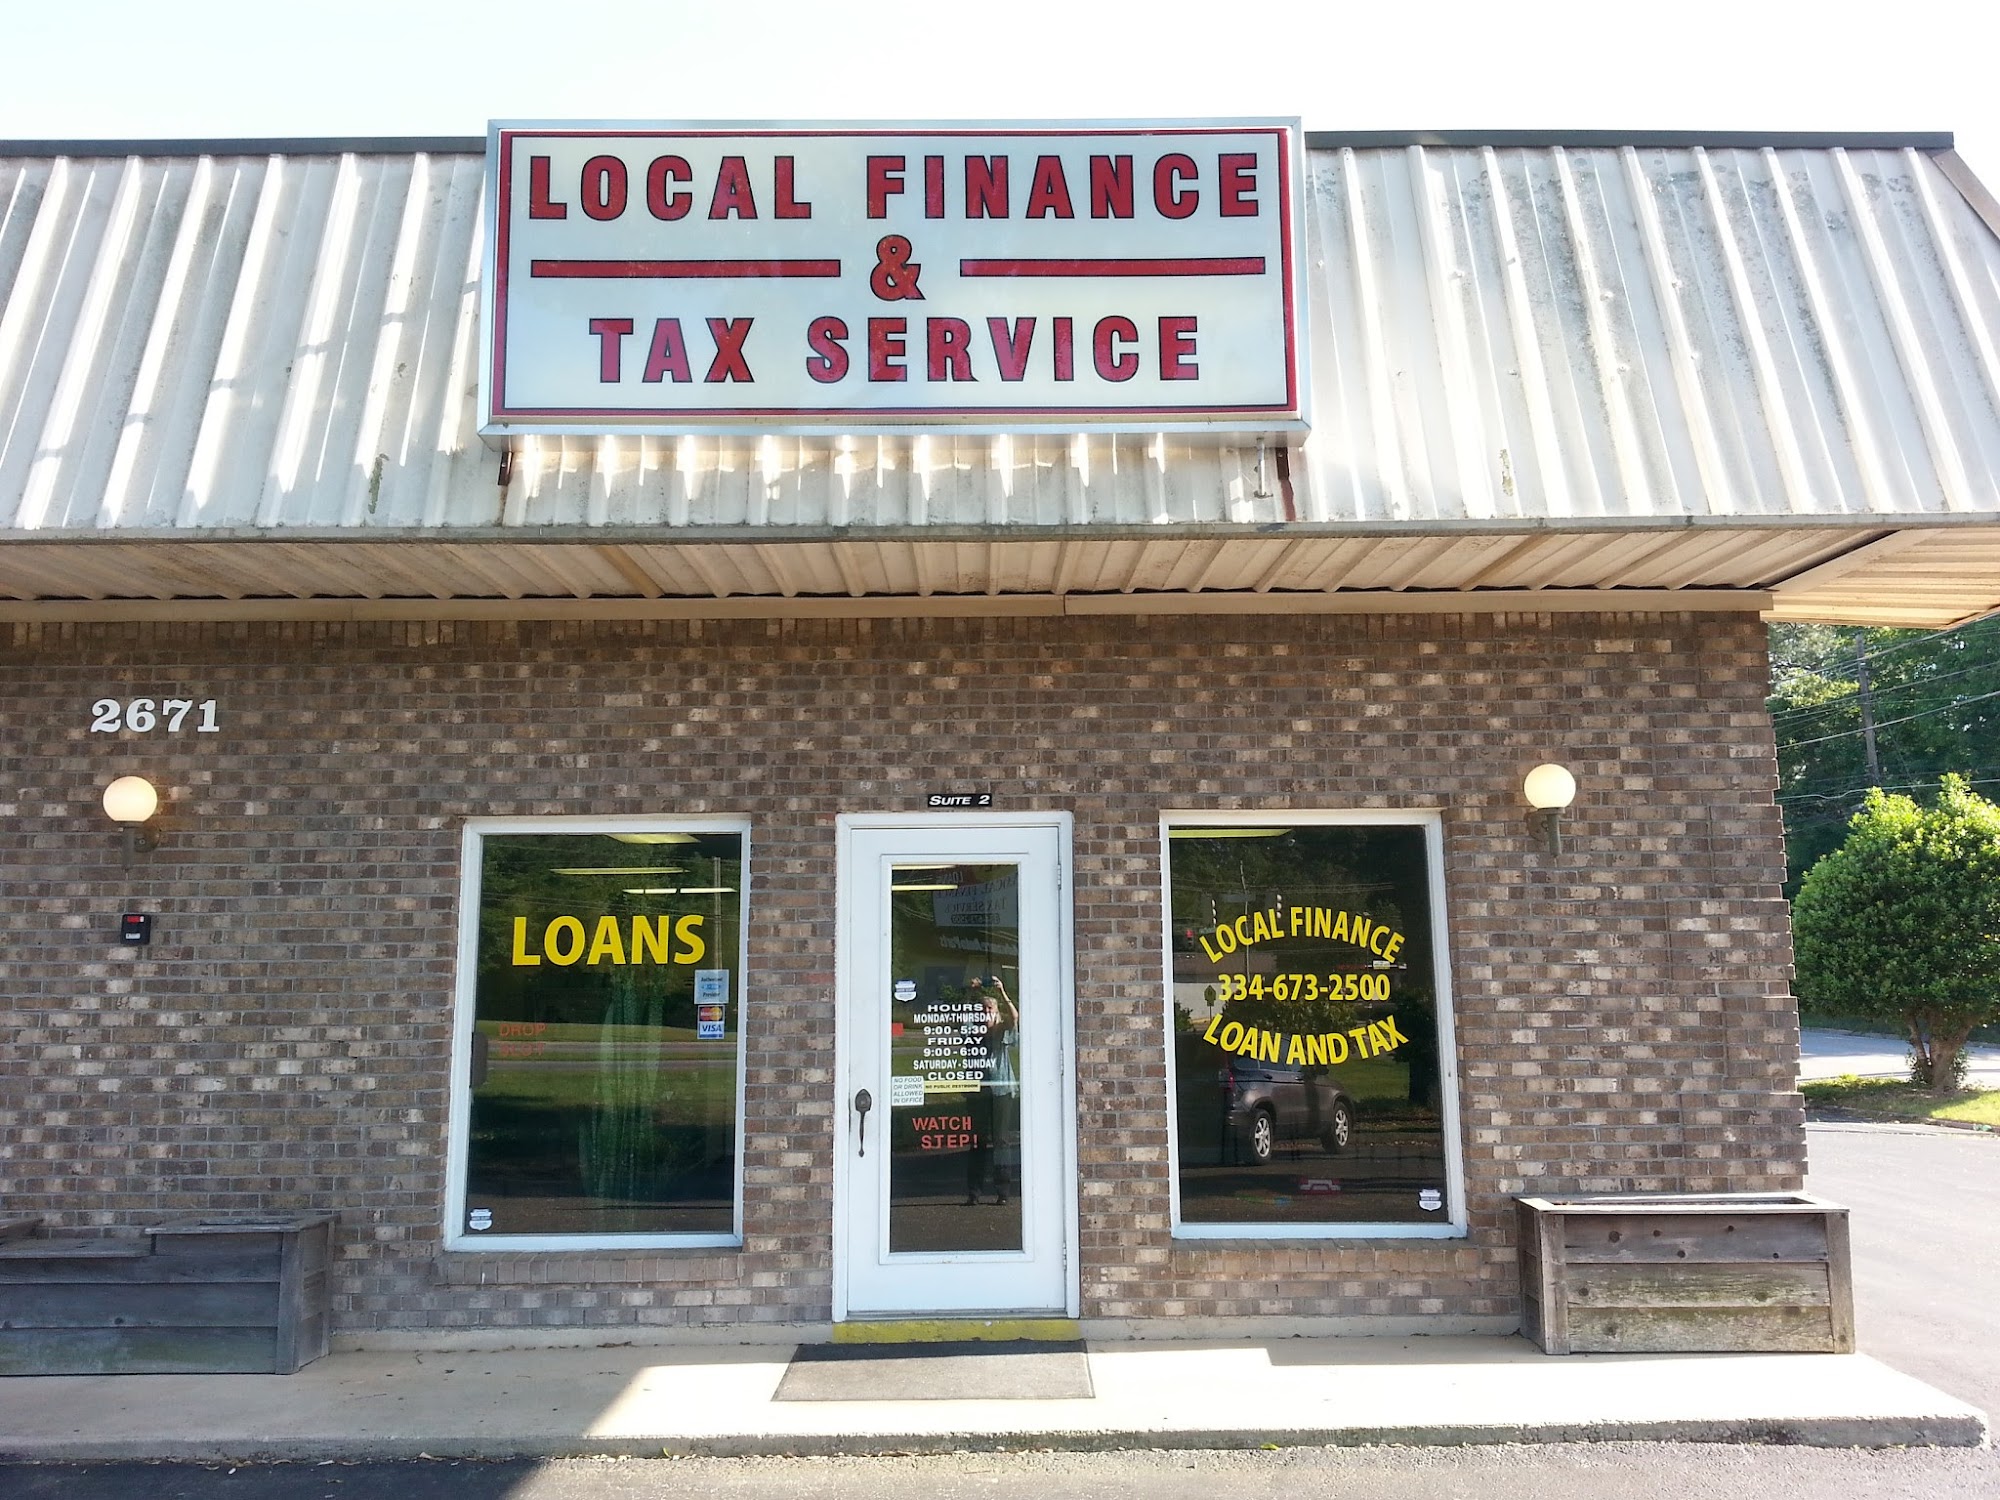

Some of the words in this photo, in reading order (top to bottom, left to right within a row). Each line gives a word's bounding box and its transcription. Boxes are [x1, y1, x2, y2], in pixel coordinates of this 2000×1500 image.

[528, 154, 812, 222] LOCAL
[865, 151, 1261, 221] FINANCE
[868, 234, 926, 302] &
[589, 316, 755, 384] TAX
[805, 315, 1201, 384] SERVICE
[90, 698, 220, 733] 2671
[978, 795, 990, 805] 2
[512, 915, 706, 966] LOANS
[1200, 909, 1284, 963] LOCAL
[1291, 907, 1405, 963] FINANCE
[1218, 974, 1391, 1001] 334-673-2500
[927, 1004, 984, 1012] HOURS
[913, 1013, 996, 1024] MONDAY-THURSDAY
[500, 1023, 546, 1036] DROP
[923, 1026, 951, 1035] 9:00
[960, 1025, 988, 1034] 5:30
[927, 1037, 983, 1045] FRIDAY
[1203, 1013, 1281, 1064] LOAN
[1286, 1032, 1349, 1065] AND
[1348, 1015, 1409, 1059] TAX
[923, 1048, 951, 1056] 9:00
[960, 1047, 987, 1056] 6:00
[927, 1071, 984, 1080] CLOSED
[912, 1116, 973, 1131] WATCH
[921, 1134, 978, 1149] STEP!
